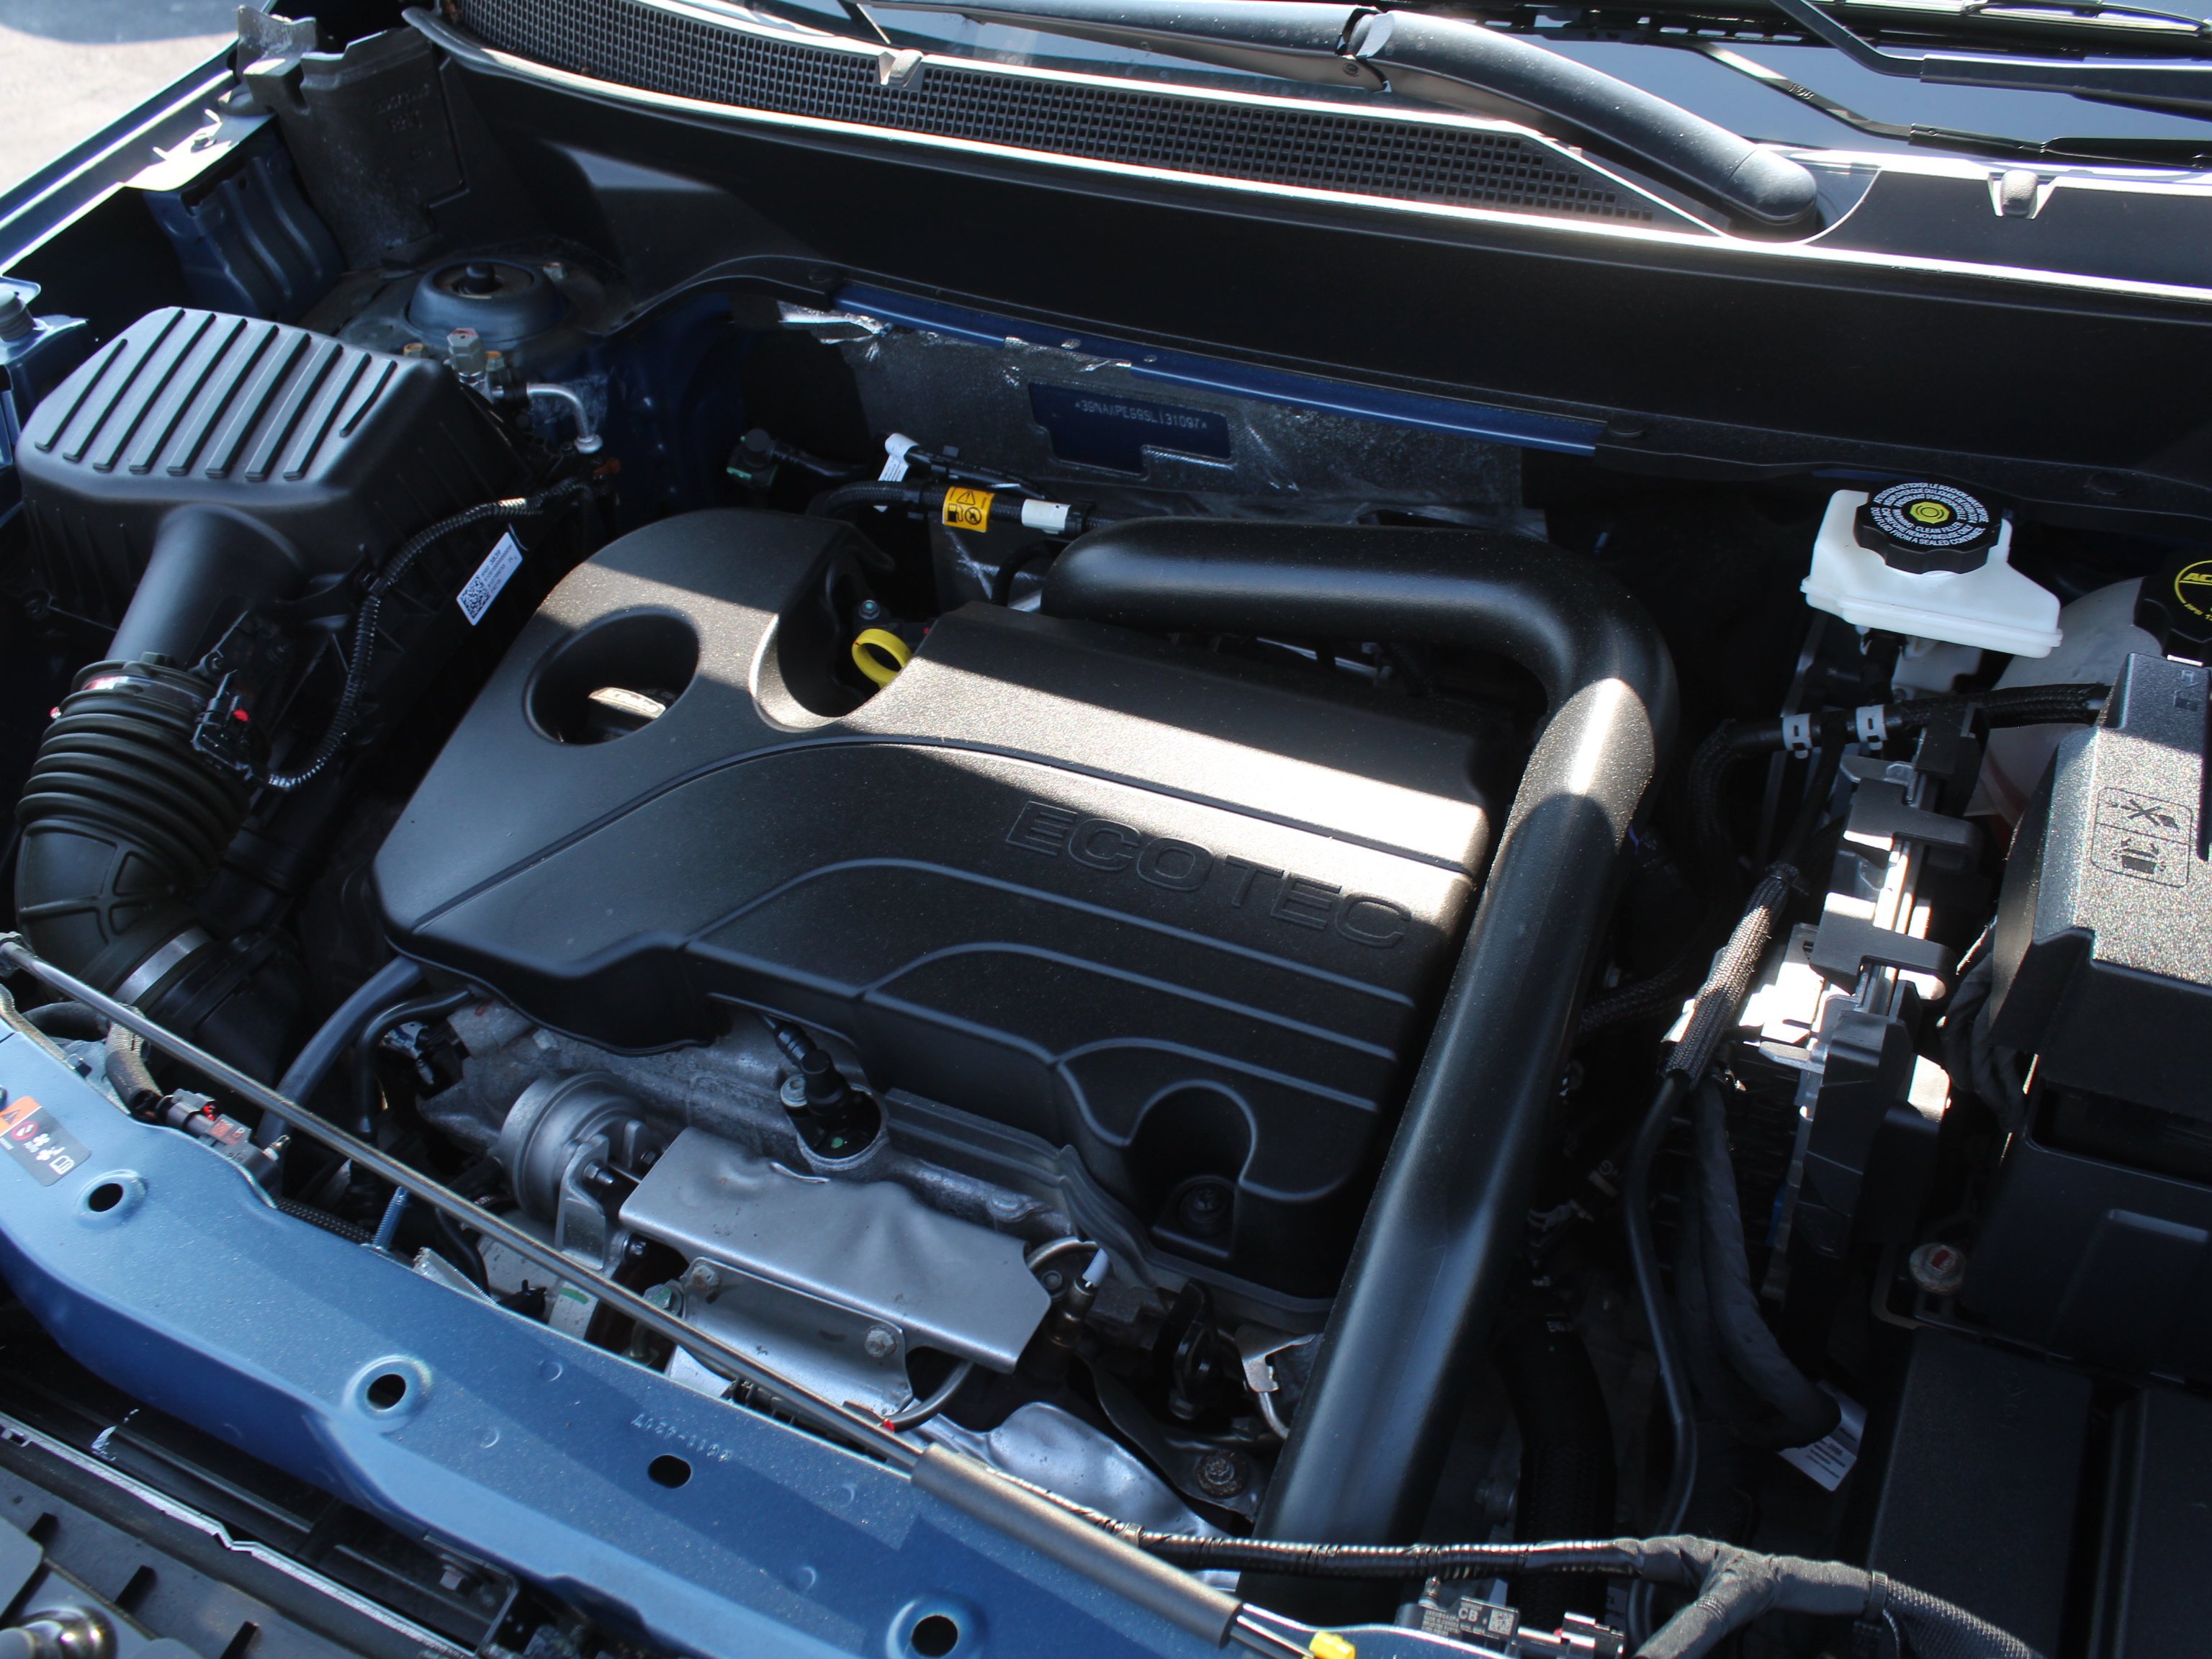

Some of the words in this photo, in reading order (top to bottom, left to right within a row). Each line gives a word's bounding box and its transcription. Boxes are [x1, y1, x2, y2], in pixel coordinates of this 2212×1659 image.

[2182, 572, 2212, 583] AC
[1005, 800, 1412, 948] ECOTEC
[1458, 1607, 1478, 1622] CB
